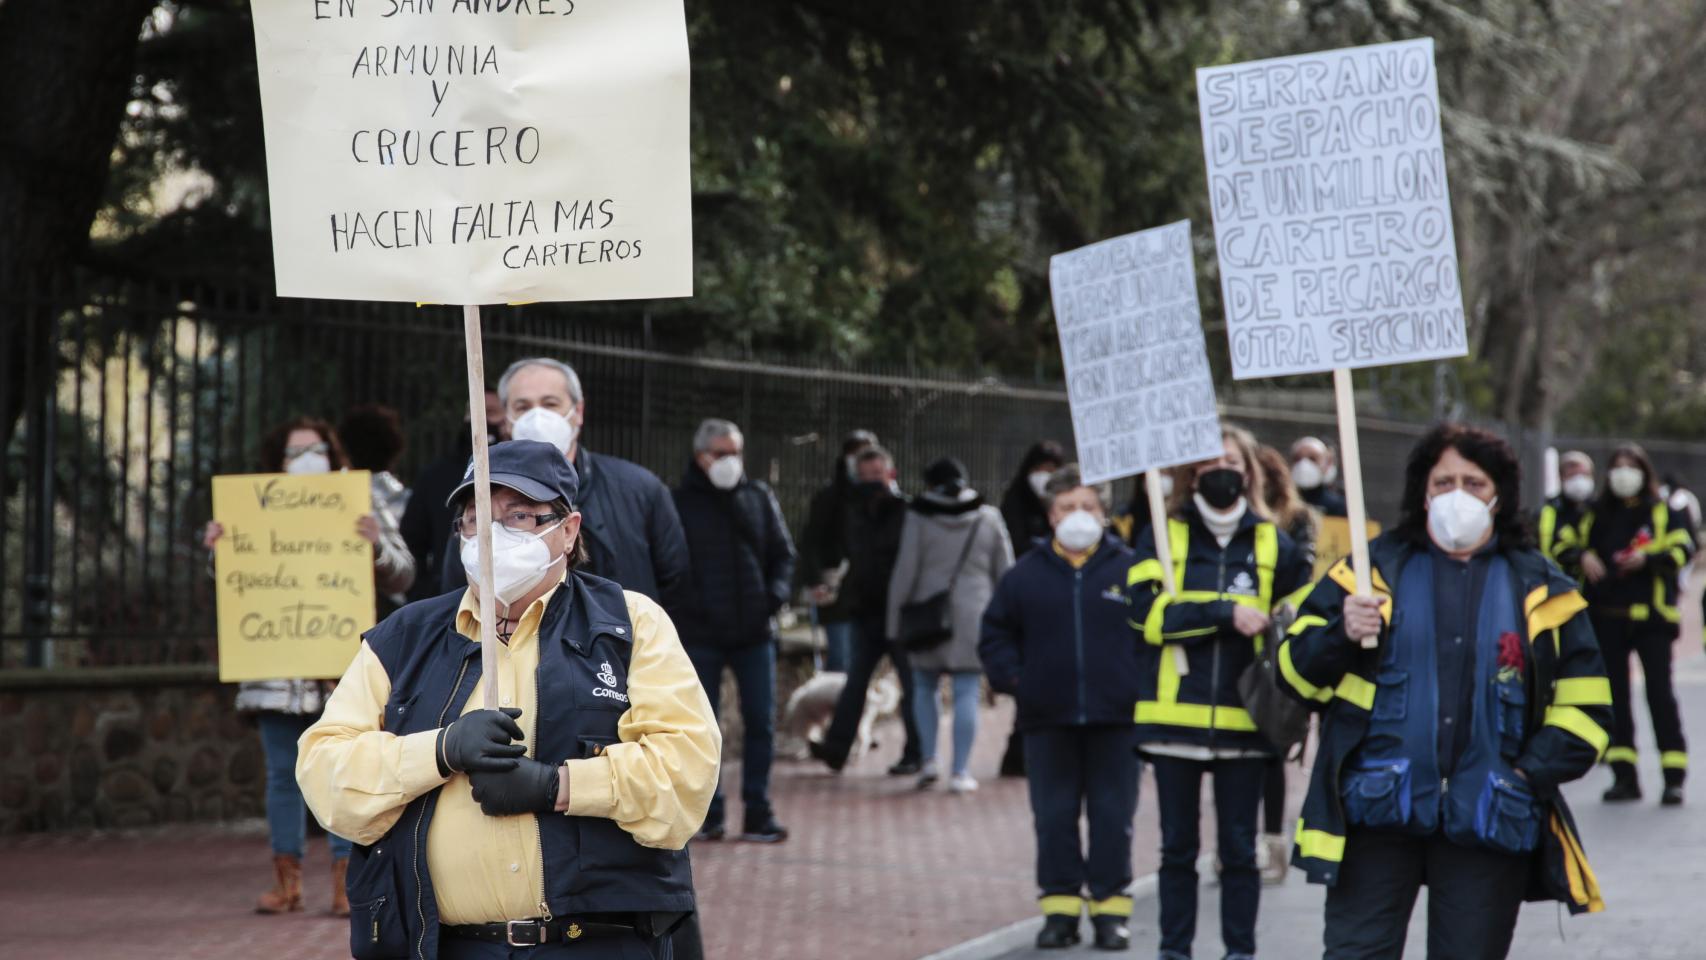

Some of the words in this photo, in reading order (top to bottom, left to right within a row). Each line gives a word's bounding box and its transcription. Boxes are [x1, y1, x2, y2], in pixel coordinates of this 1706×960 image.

[314, 0, 355, 21] EN
[380, 0, 434, 18] SAN
[351, 44, 499, 79] ARMUNIA
[1205, 47, 1429, 117] SERRANO
[351, 126, 540, 167] CRUCERO
[1209, 93, 1436, 168] DESPACHO
[1213, 171, 1258, 223] DE
[1262, 164, 1305, 216] UN
[1311, 148, 1444, 213] MILLON
[330, 208, 433, 253] HACEN
[451, 199, 539, 245] FALTA
[553, 198, 614, 233] MAS
[502, 239, 642, 270] CARTEROS
[1221, 206, 1446, 268] CARTERO
[1227, 273, 1281, 323] DE
[1293, 255, 1458, 317] RECARGO
[1232, 323, 1319, 369] OTRA
[1328, 307, 1465, 362] SECCION
[226, 563, 303, 597] queda
